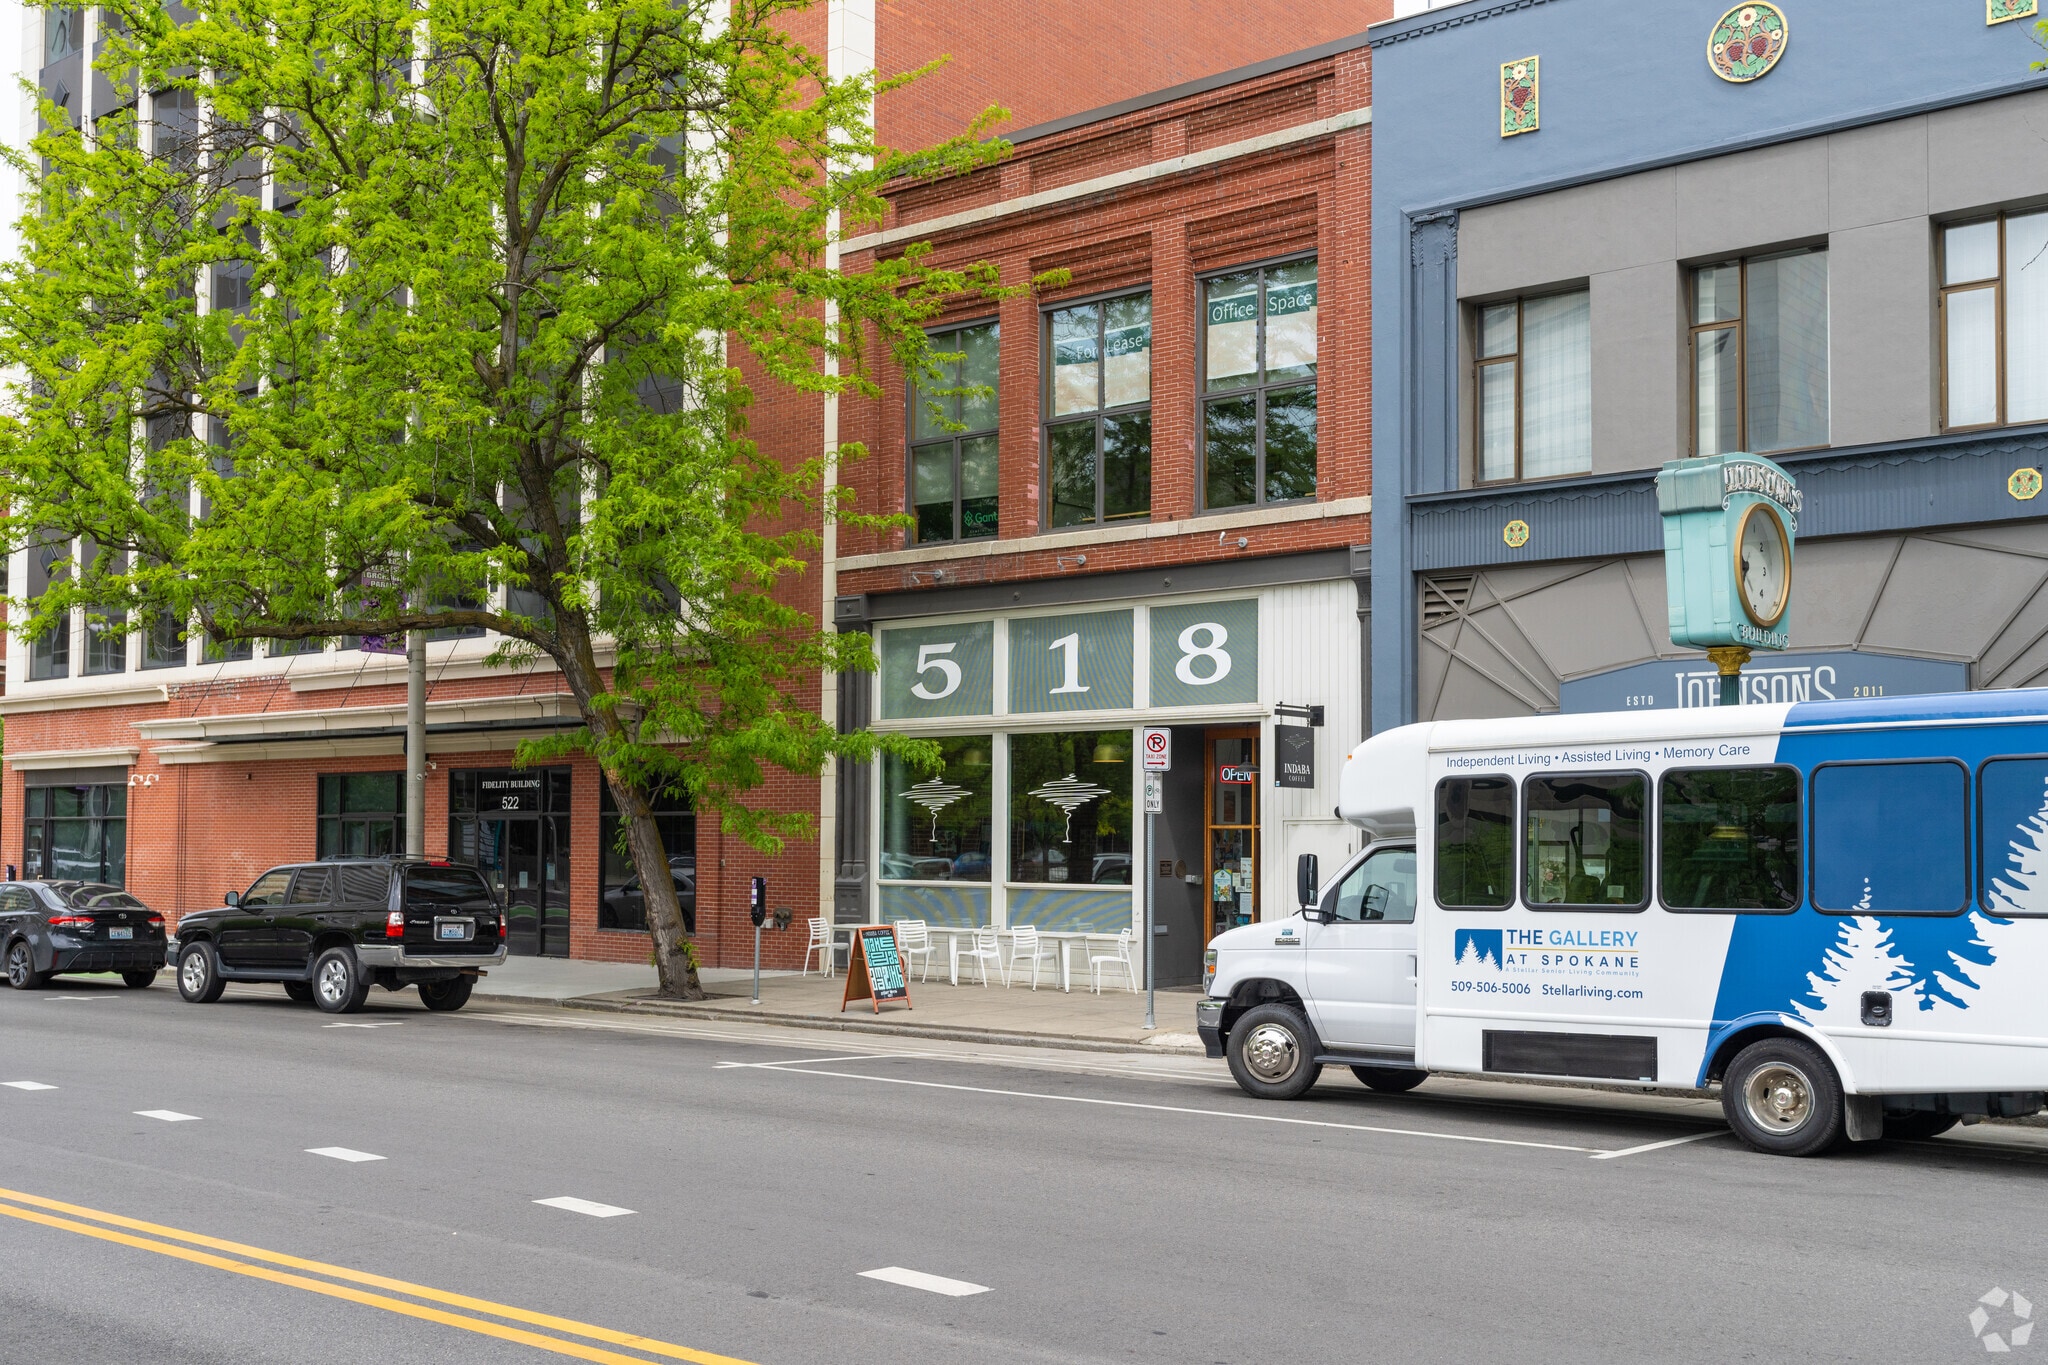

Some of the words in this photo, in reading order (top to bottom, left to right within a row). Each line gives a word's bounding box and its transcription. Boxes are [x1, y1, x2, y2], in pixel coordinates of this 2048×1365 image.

[1212, 301, 1254, 321] Office
[1269, 292, 1313, 315] Space
[1076, 345, 1098, 360] For
[1106, 335, 1143, 353] Lease
[1759, 542, 1764, 553] 2
[1762, 566, 1767, 577] 3
[1759, 588, 1764, 599] 4
[1741, 623, 1791, 648] BUILDING
[1853, 685, 1884, 697] 2011
[1626, 695, 1654, 707] ESTD
[1446, 755, 1515, 769] Independent
[1518, 753, 1551, 767] Living
[1561, 750, 1612, 763] Assisted
[1615, 749, 1651, 763] Living
[1663, 747, 1715, 760] Memory
[1718, 744, 1751, 757] Care
[1222, 767, 1251, 781] OPEN
[1284, 762, 1311, 775] INDABA
[482, 780, 509, 789] FIDELITY
[510, 779, 540, 788] BUILDING
[1288, 775, 1307, 783] COFFEE
[501, 796, 519, 810] 522
[1146, 799, 1160, 809] ONLY
[1506, 929, 1543, 945] THE
[1549, 930, 1639, 947] GALLERY
[1506, 954, 1528, 965] AT
[1541, 954, 1639, 968] SPOKANE
[1568, 968, 1593, 976] Living
[1595, 969, 1640, 977] Community
[1451, 980, 1531, 995] 509-506-5006
[1542, 983, 1643, 1001] Stellarliving.com
